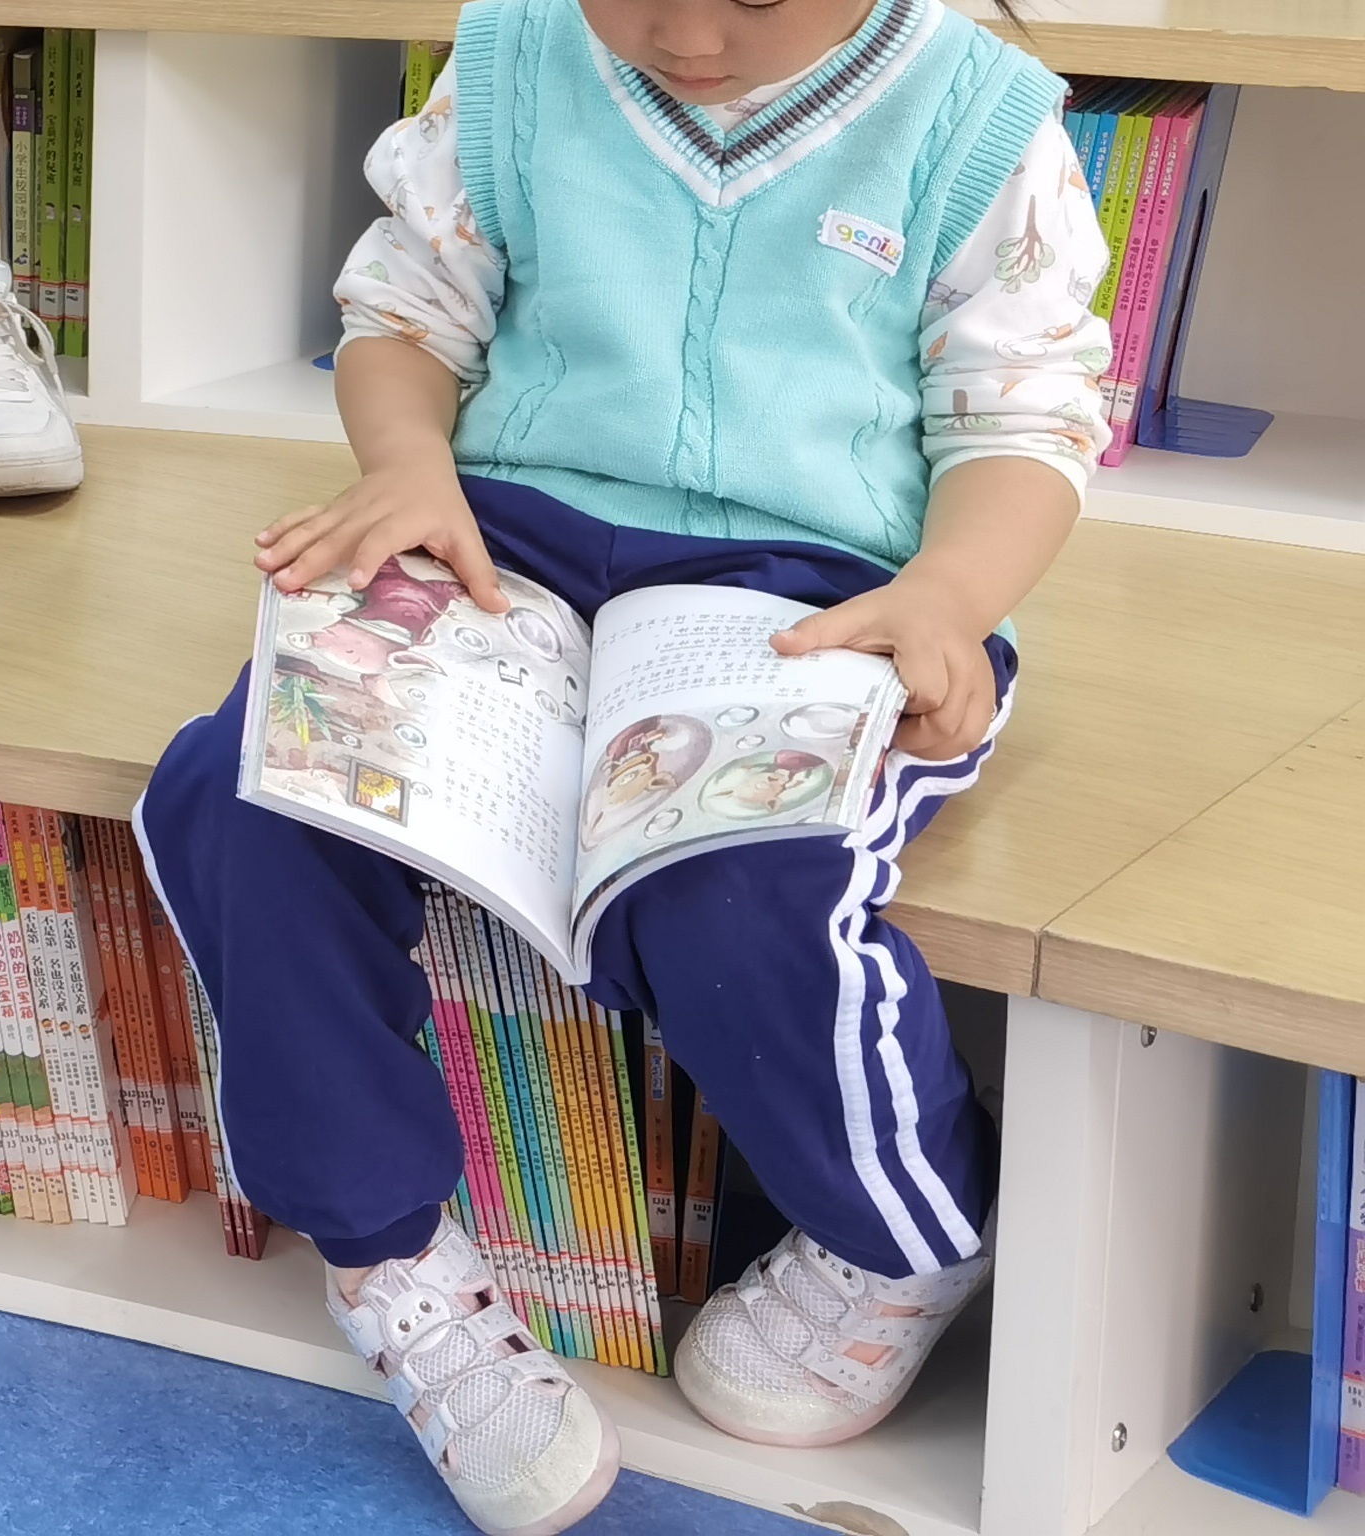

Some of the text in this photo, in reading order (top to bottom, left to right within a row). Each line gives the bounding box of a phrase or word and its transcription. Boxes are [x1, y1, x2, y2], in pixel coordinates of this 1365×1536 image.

[6, 930, 34, 1020] 奶奶的百宝箱
[24, 911, 51, 1010] 不是第一名也没关系
[42, 915, 68, 1013] 不是第一名也没关系
[61, 916, 88, 1015] 不是第一名也没关系
